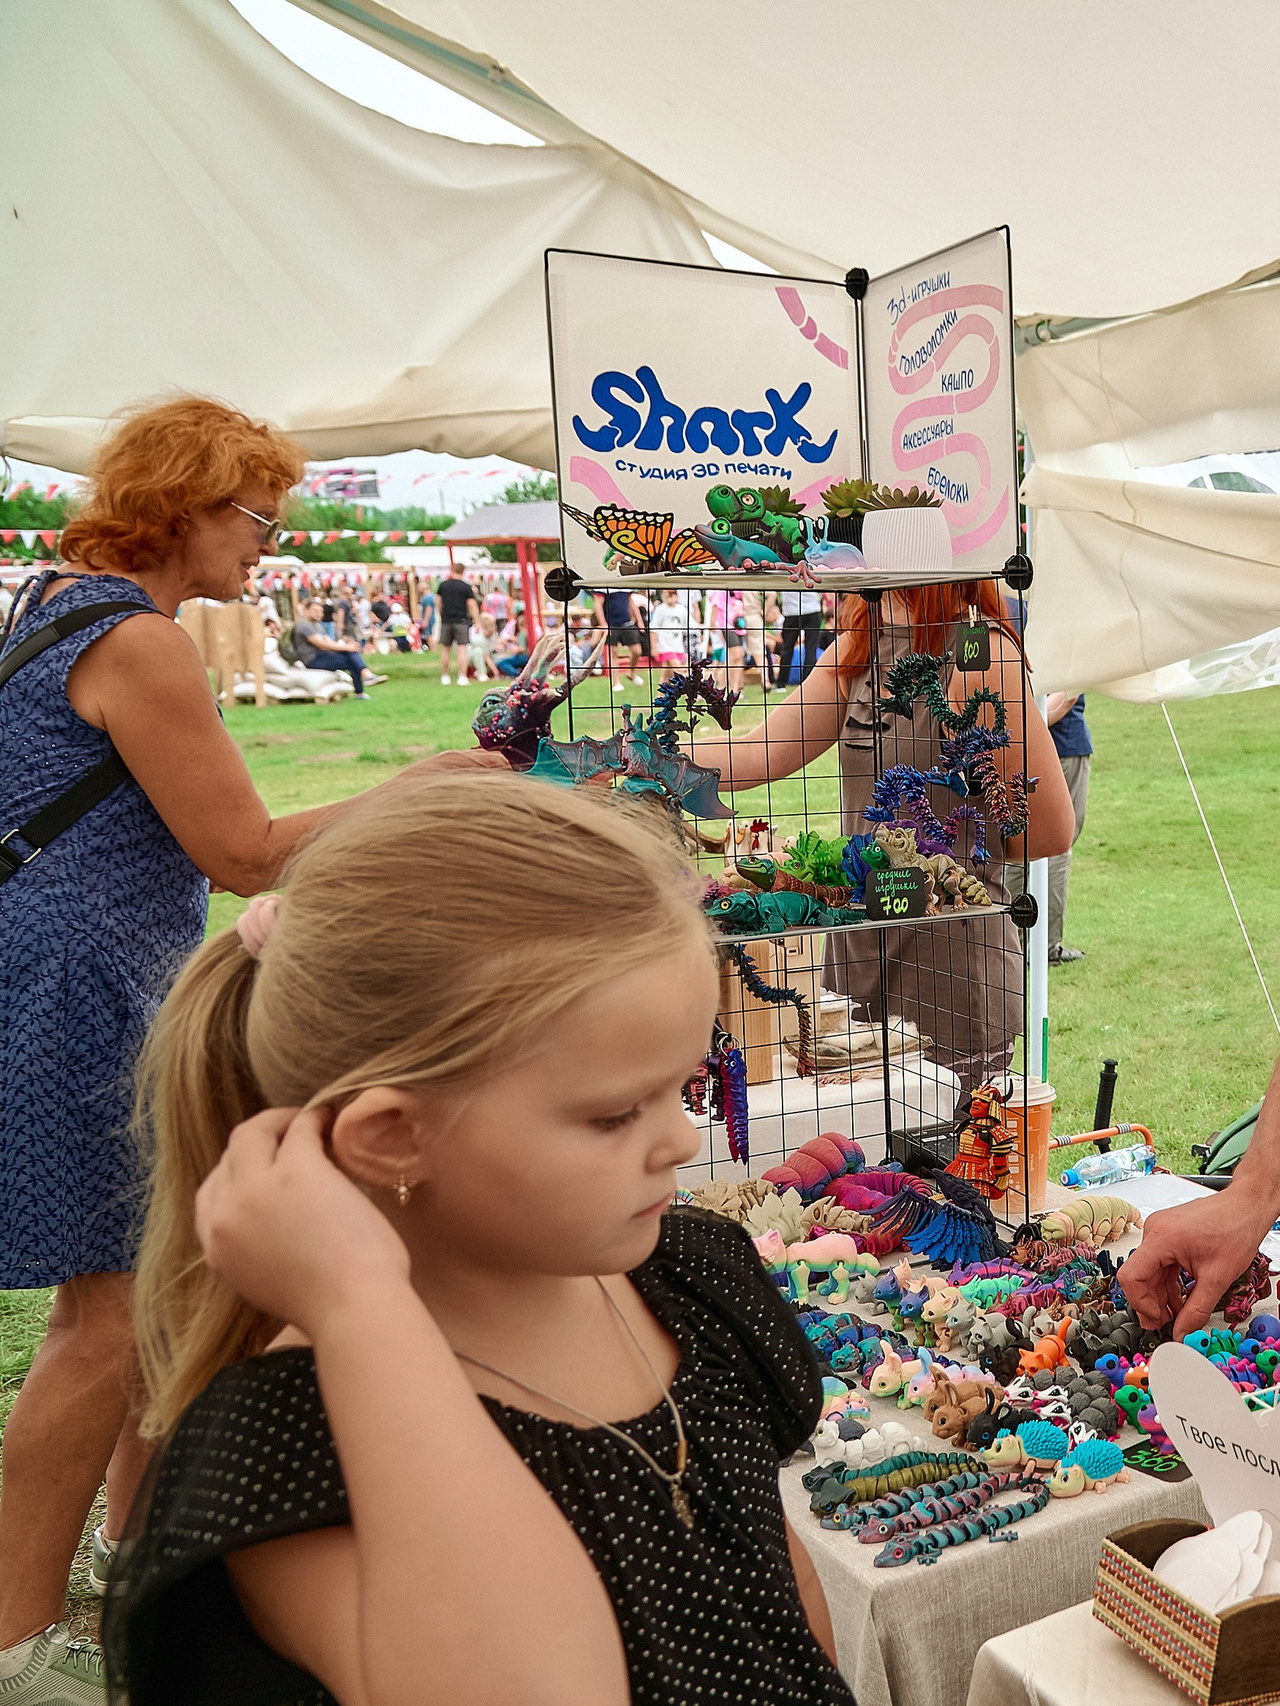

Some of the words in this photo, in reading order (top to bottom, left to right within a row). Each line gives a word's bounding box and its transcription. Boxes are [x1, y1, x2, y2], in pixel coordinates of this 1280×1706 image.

[690, 463, 720, 478] 3D
[724, 462, 792, 480] печати
[880, 895, 909, 916] 700
[1175, 1414, 1228, 1455] Твое
